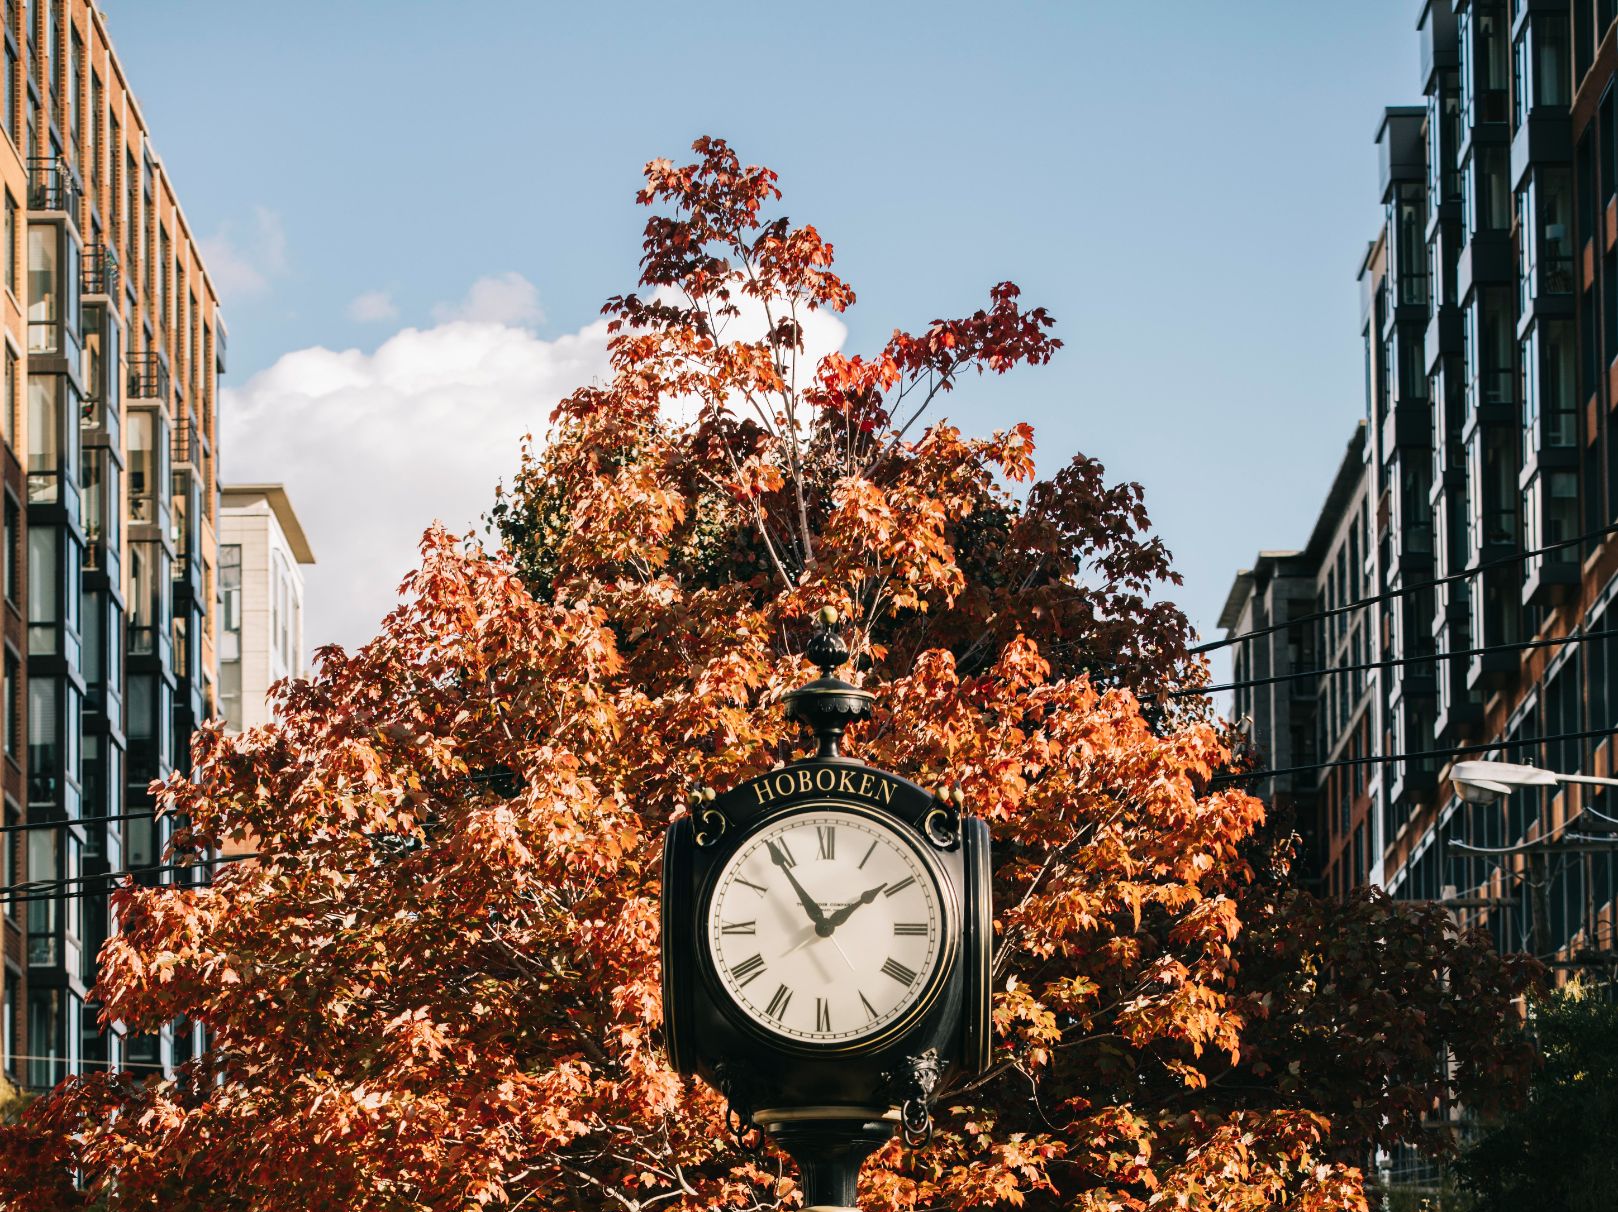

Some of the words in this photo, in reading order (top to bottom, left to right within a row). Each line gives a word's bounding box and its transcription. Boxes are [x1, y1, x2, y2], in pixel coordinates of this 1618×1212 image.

[752, 768, 899, 805] HOBOKEN
[816, 826, 836, 860] XII
[857, 839, 880, 871] I
[734, 871, 768, 899] X
[883, 875, 917, 899] II
[721, 918, 756, 936] IX
[893, 923, 928, 936] III
[730, 952, 768, 988] VIII
[764, 983, 794, 1021] VII
[815, 997, 833, 1032] VI
[858, 989, 879, 1022] V
